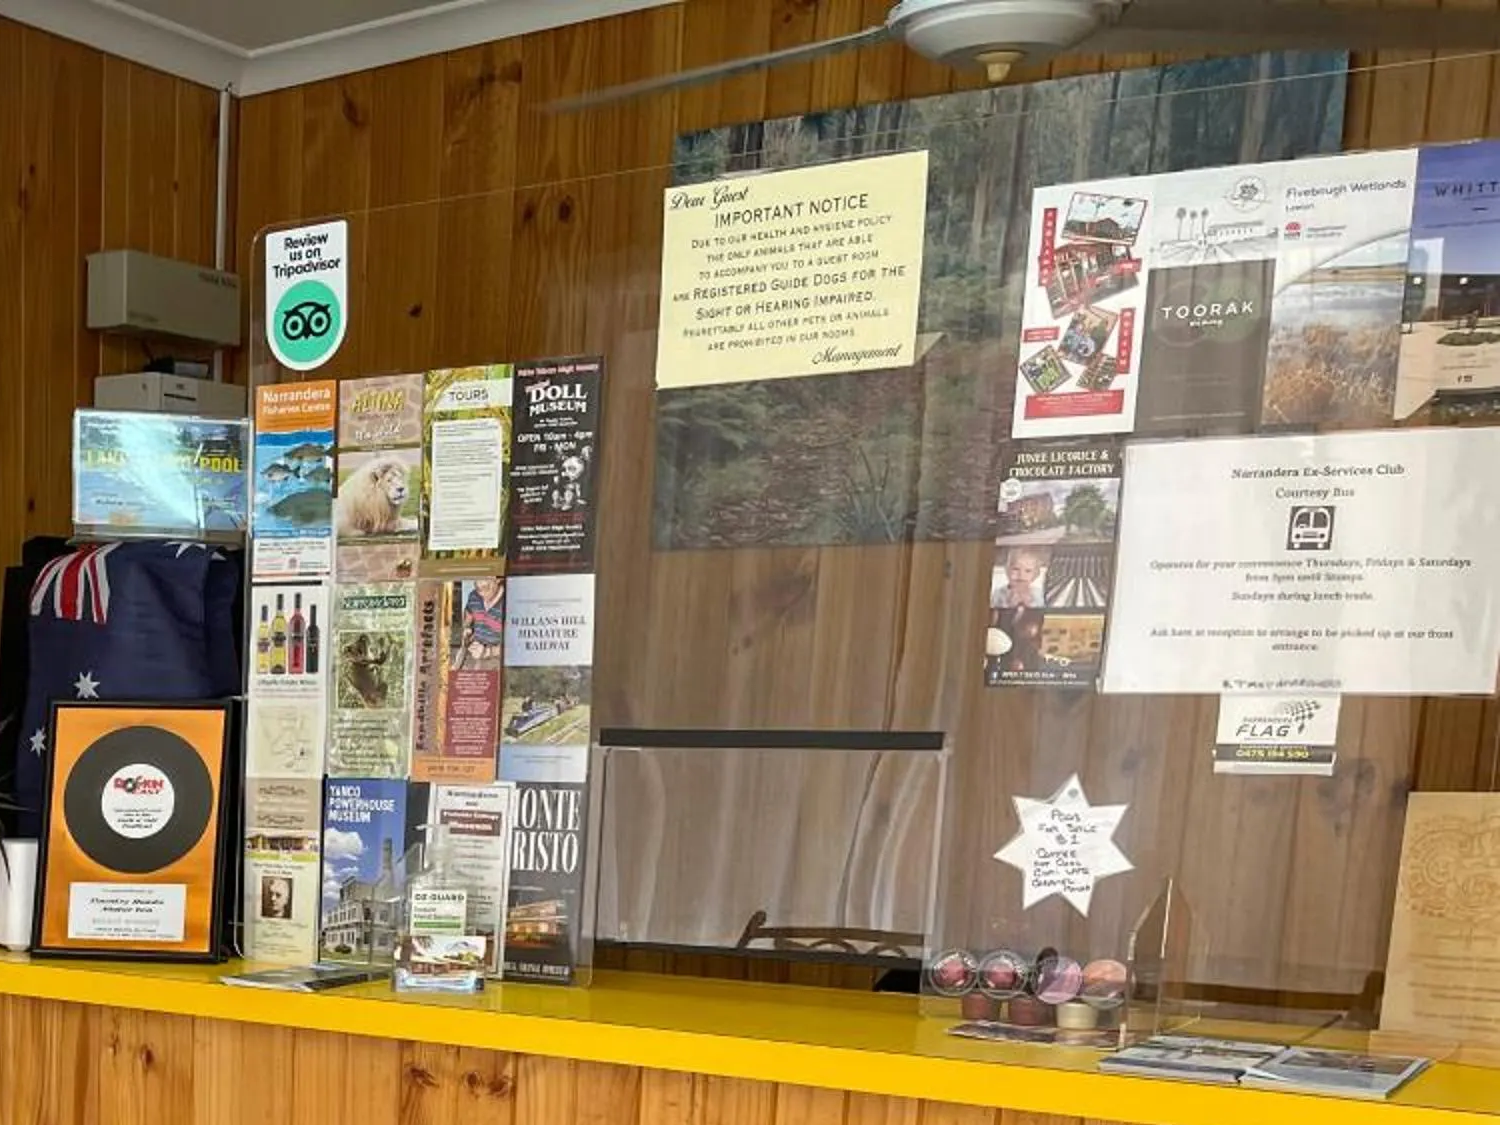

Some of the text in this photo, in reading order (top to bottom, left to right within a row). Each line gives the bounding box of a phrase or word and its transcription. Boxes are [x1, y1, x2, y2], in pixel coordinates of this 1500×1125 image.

[1350, 180, 1407, 193] Wetlands
[669, 185, 750, 211] Dear Guest
[714, 193, 869, 229] IMPORTANT NOTICE
[691, 214, 892, 250] DUE TO OUR HEALTH AND HYGIENE POLICY
[284, 233, 329, 251] Review
[707, 233, 874, 263] THE ONLY ANIMALS THAT ARE ABLE
[289, 247, 321, 262] us on
[272, 258, 341, 279] Tripadvisor
[699, 249, 880, 281] TO ACCOMPANY YOU TO A GUEST ROOM
[693, 281, 768, 300] REGISTERED
[770, 277, 809, 292] GUIDE
[813, 272, 848, 287] DOGS
[851, 268, 877, 283] FOR
[880, 265, 907, 278] THE
[695, 305, 733, 321] SIGHT
[735, 303, 752, 317] OR
[754, 297, 811, 315] HEARING
[1160, 300, 1254, 320] TOORAK
[747, 321, 766, 332] ALL
[767, 317, 799, 330] OTHER
[802, 315, 827, 326] PETS
[829, 312, 843, 323] OR
[845, 308, 890, 321] ANIMALS
[707, 341, 726, 352] ARE
[727, 335, 784, 349] PROHIBITED
[786, 334, 798, 343] IN
[800, 331, 820, 342] OUR
[811, 343, 904, 366] Management
[263, 387, 332, 403] Narrandera
[449, 387, 490, 402] TOURS
[530, 383, 589, 403] DOLL
[528, 401, 587, 417] MUSEUM
[517, 433, 541, 443] OPEN
[1100, 449, 1110, 461] &
[201, 455, 242, 474] POOL
[1068, 463, 1116, 476] FACTORY
[1230, 463, 1405, 479] Narrandera Ex-Services Club
[1275, 487, 1355, 500] Courtesy Bus
[1213, 560, 1236, 571] your
[1306, 557, 1363, 570] Thursdays,
[1365, 557, 1405, 570] Fridays
[1407, 558, 1415, 568] &
[1418, 556, 1472, 570] Saturdays
[1277, 591, 1311, 603] during
[1313, 591, 1343, 601] lunch
[561, 614, 587, 626] HILL
[517, 628, 579, 639] MINIATURE
[1235, 723, 1292, 737] FLAG
[329, 784, 361, 798] YANCO
[329, 797, 396, 812] POWERHOUSE
[327, 810, 372, 823] MUSEUM
[512, 831, 579, 874] RISTO
